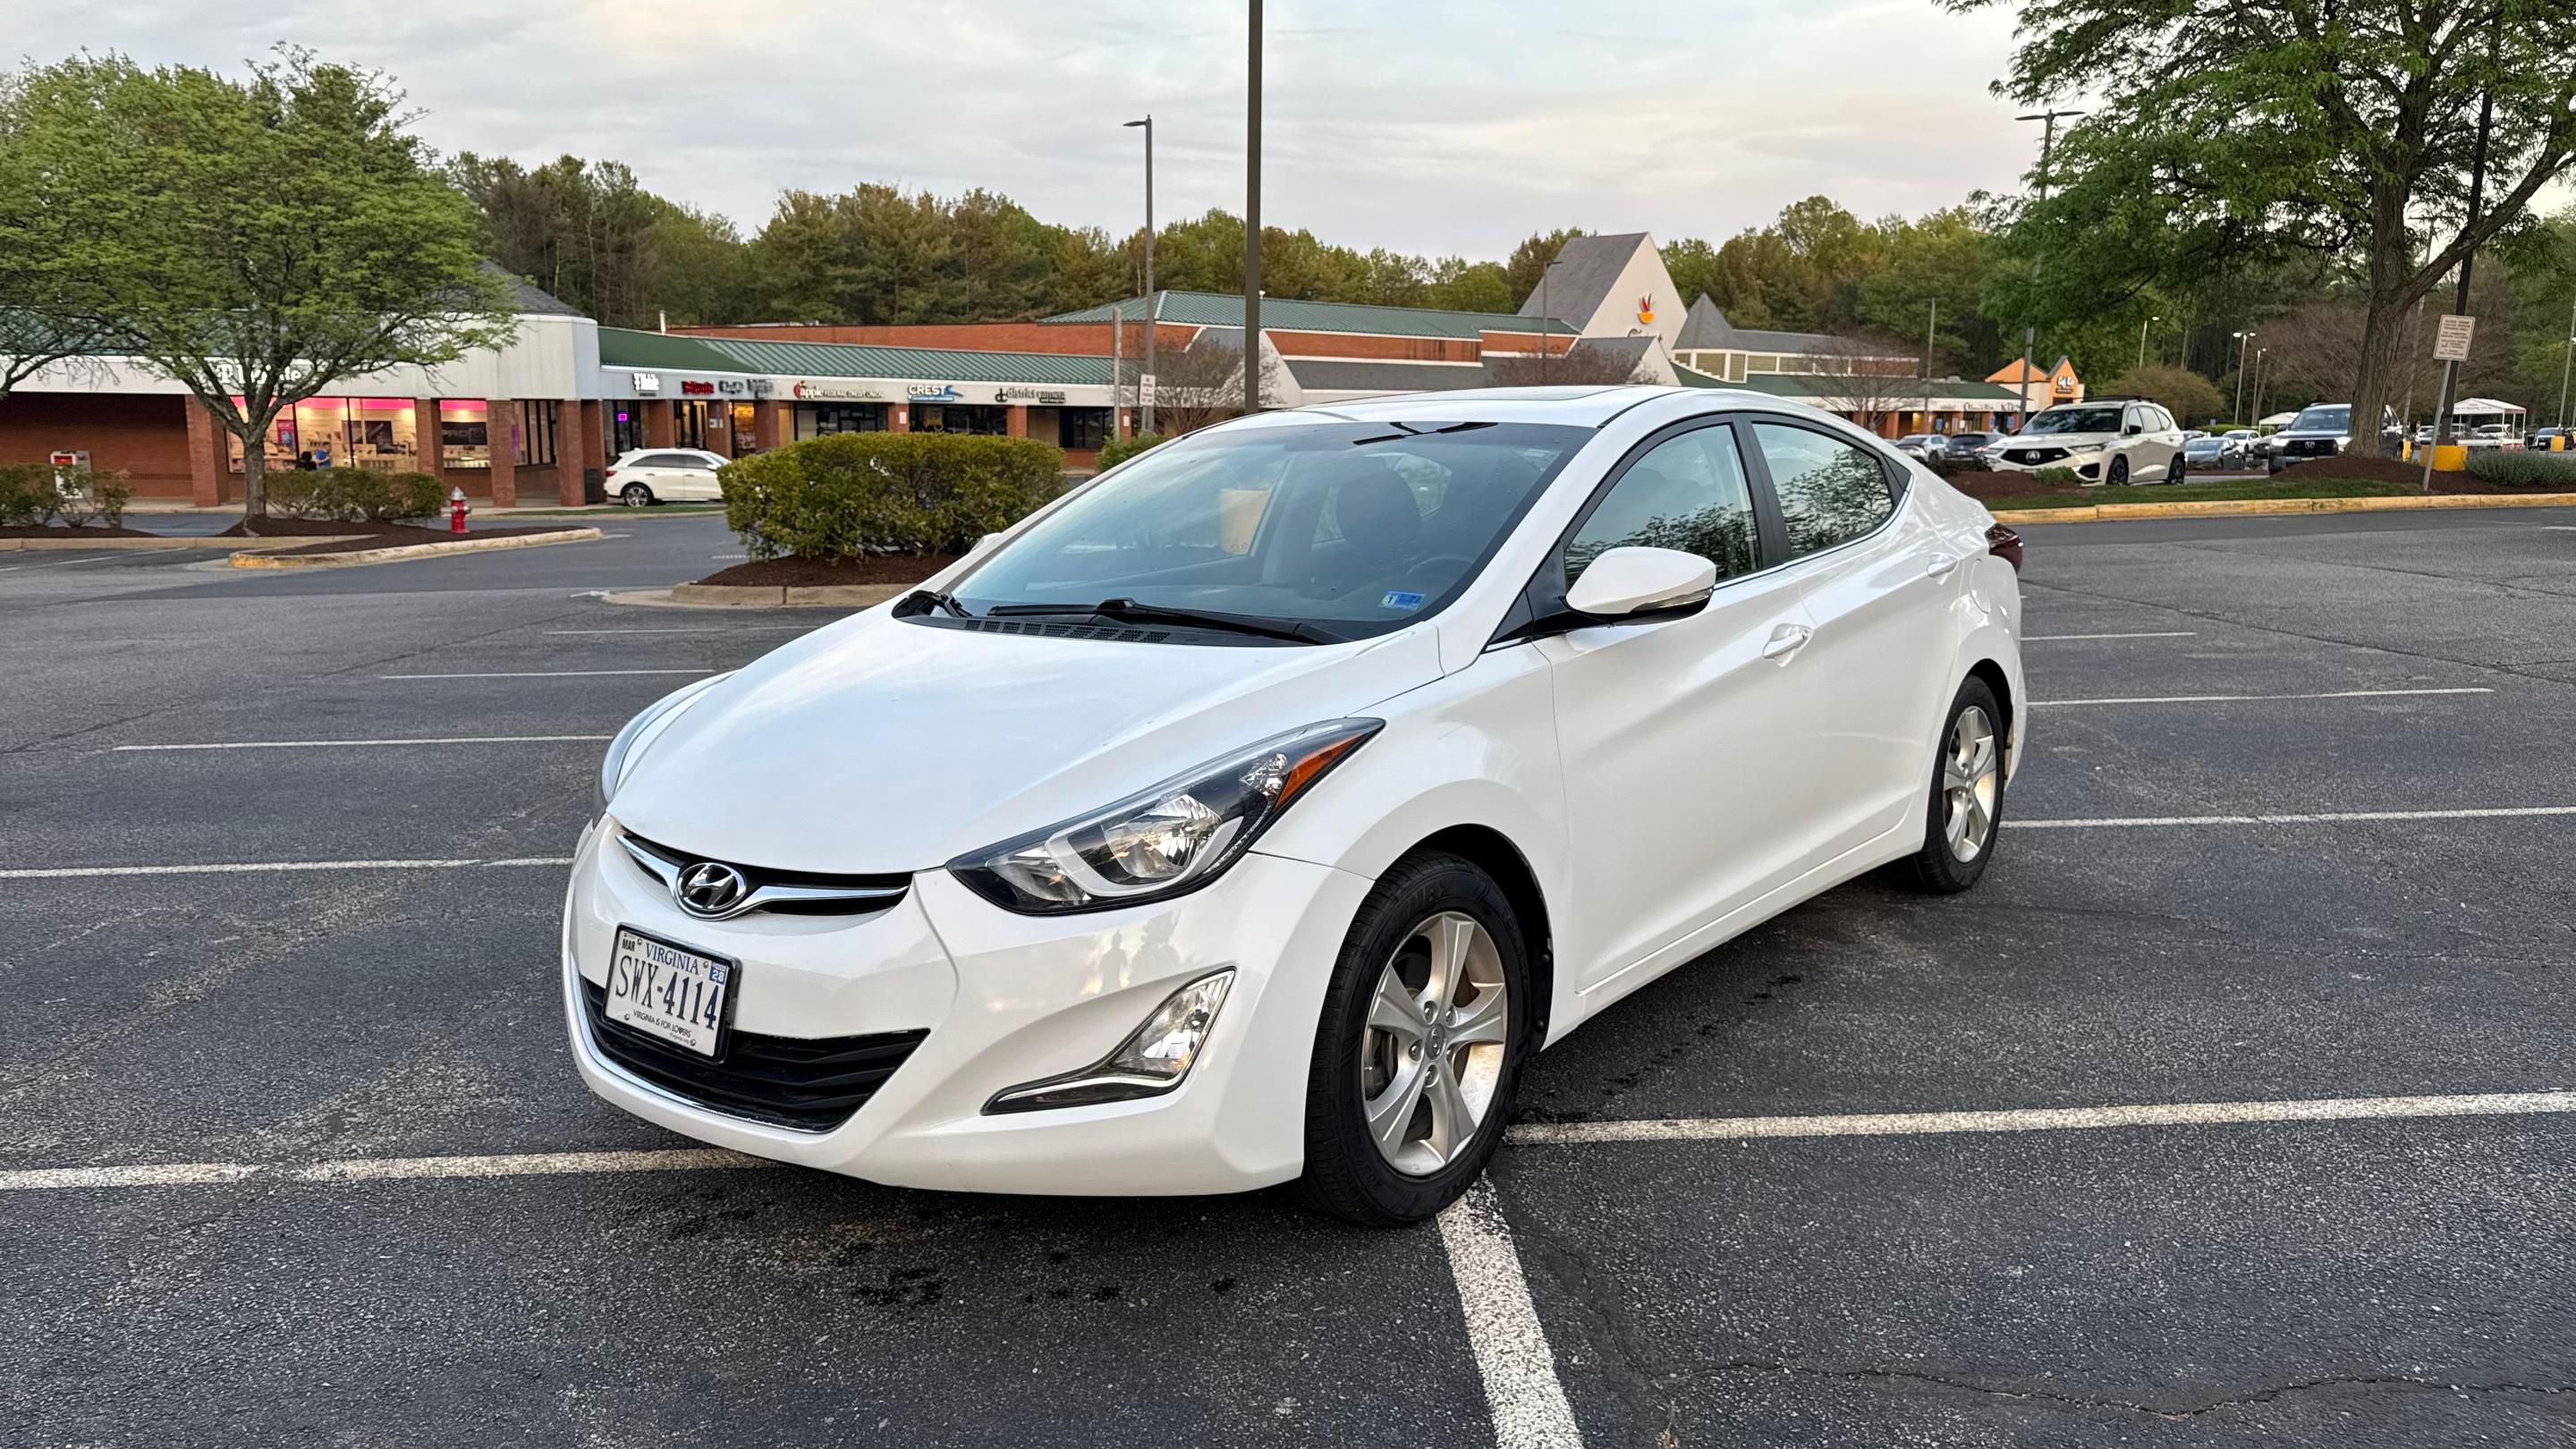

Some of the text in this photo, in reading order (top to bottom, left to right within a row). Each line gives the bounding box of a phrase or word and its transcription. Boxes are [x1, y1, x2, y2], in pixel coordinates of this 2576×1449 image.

[908, 385, 945, 395] CREST
[622, 938, 636, 952] MAR
[646, 942, 699, 975] VIRGINIA
[711, 970, 724, 982] 28
[615, 954, 719, 1030] SWX-4114
[633, 1009, 655, 1025] VIRGINIA
[660, 1020, 672, 1030] FOR
